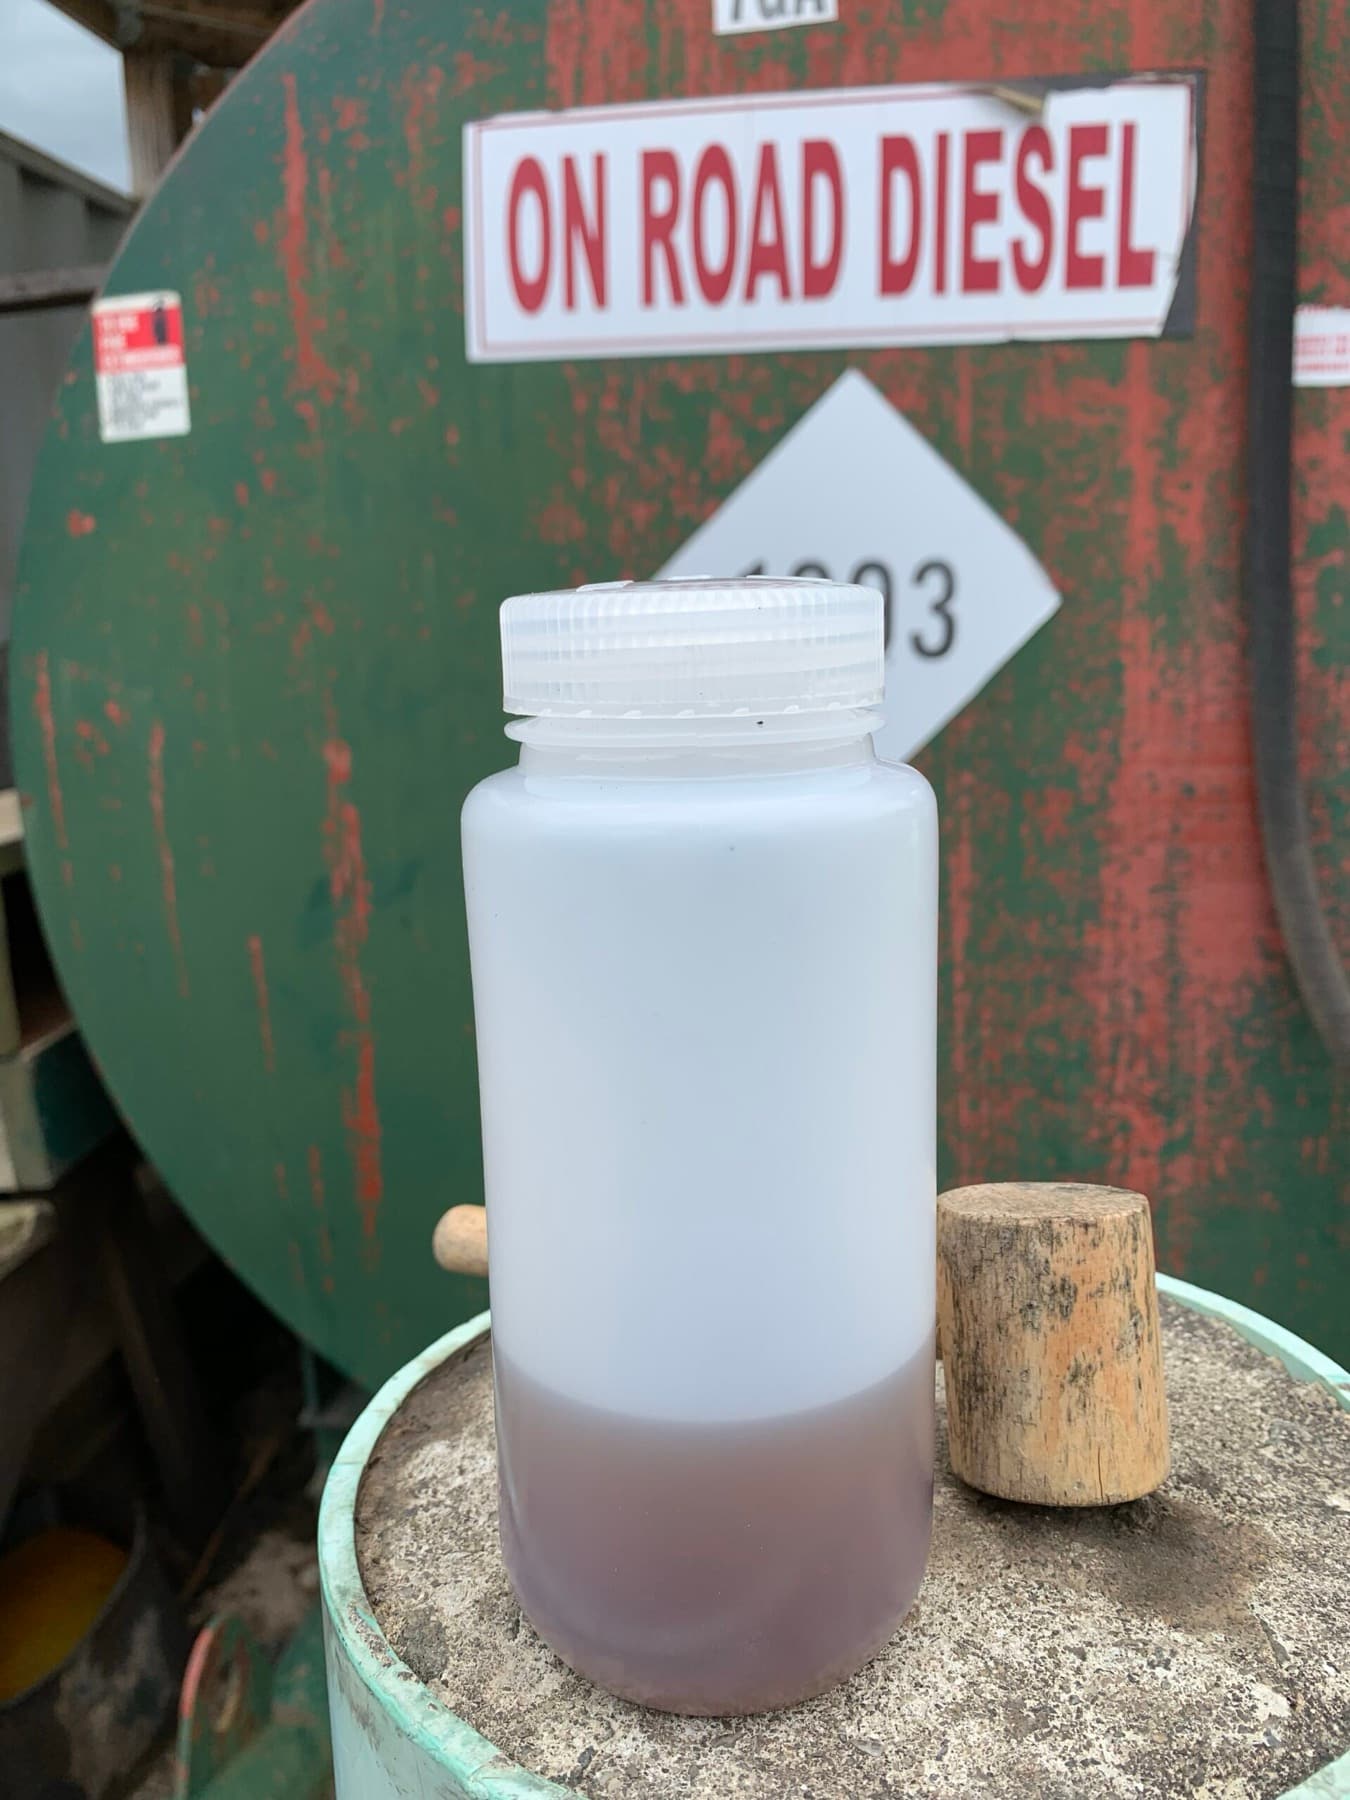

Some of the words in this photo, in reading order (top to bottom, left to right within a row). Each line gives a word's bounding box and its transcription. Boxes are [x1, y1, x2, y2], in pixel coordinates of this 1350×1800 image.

[507, 154, 608, 314] ON
[640, 139, 845, 308] ROAD
[878, 123, 1156, 296] DIESEL
